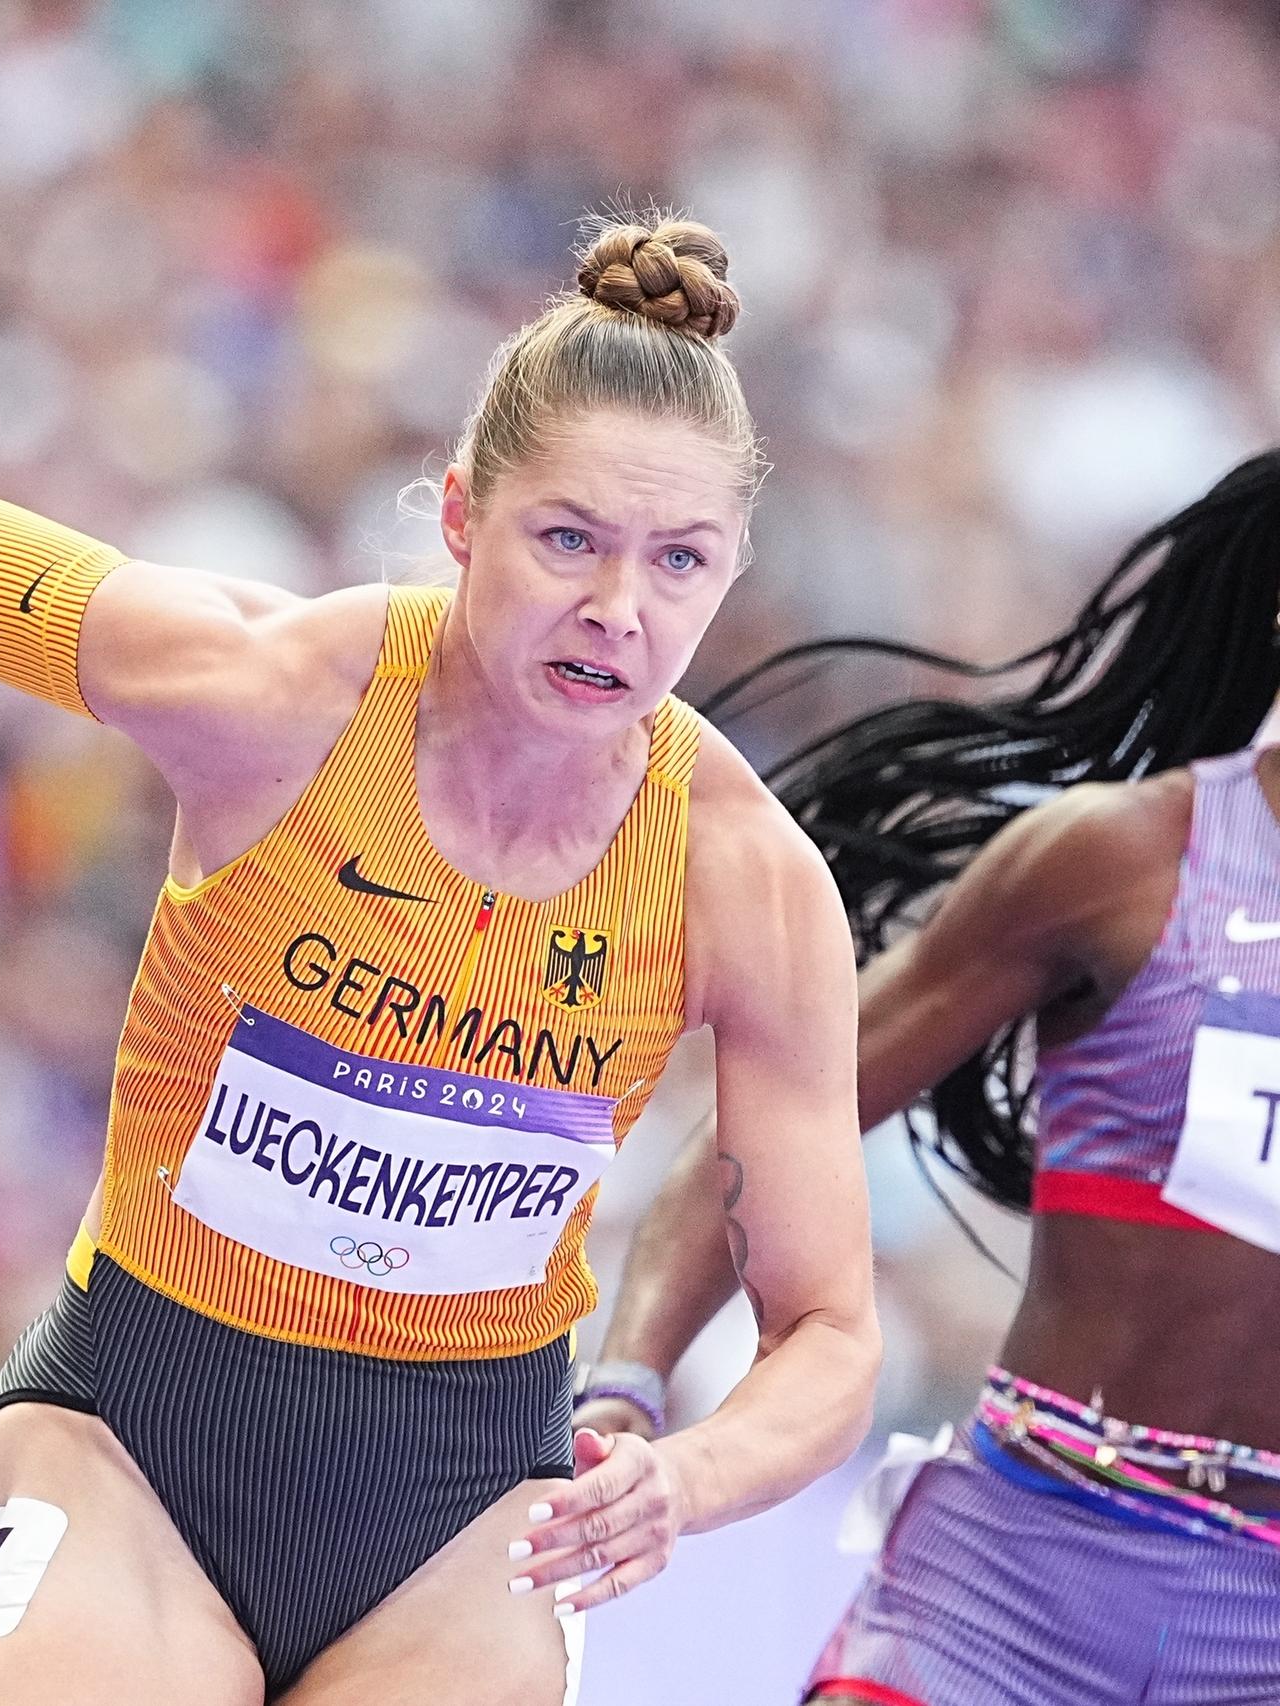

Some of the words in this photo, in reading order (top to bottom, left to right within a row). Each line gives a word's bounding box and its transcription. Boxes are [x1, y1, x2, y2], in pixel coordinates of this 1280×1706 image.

[283, 932, 623, 1086] GERMANY
[204, 1084, 579, 1228] LUECKENKEMPER
[440, 1084, 526, 1119] 2024
